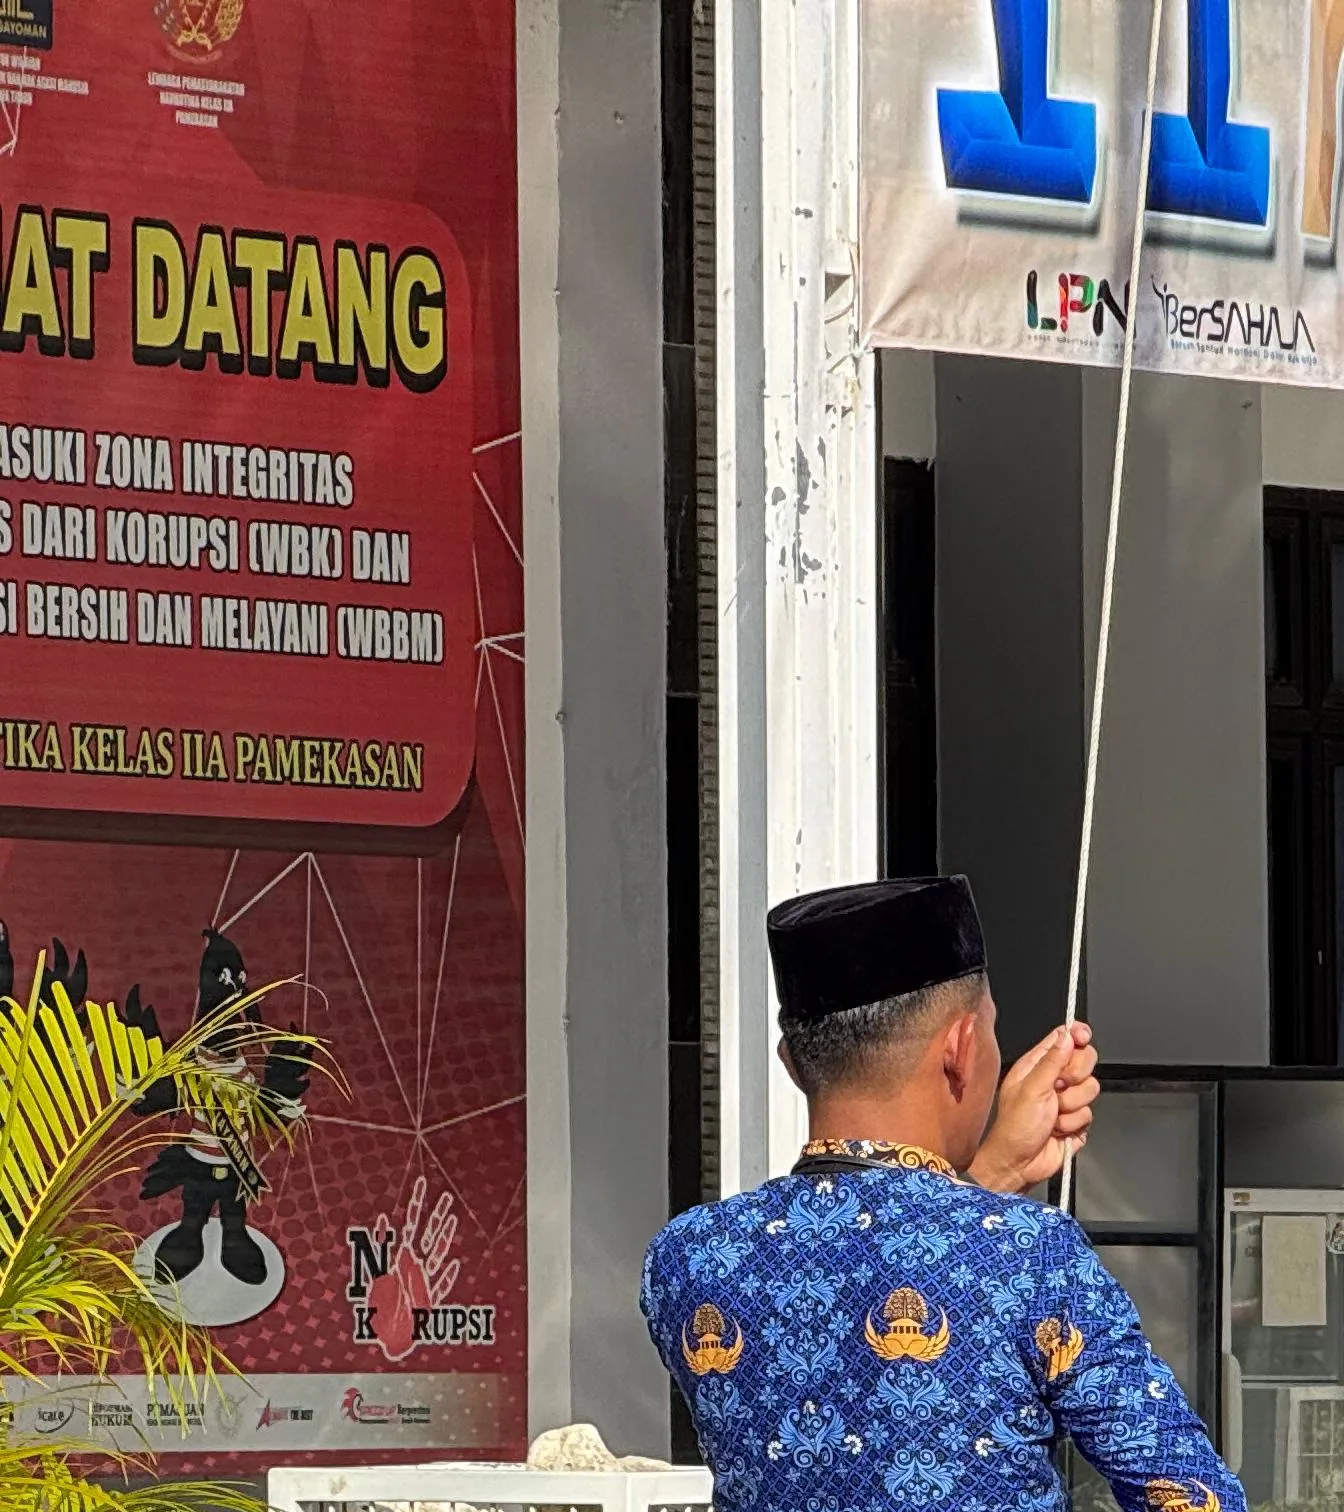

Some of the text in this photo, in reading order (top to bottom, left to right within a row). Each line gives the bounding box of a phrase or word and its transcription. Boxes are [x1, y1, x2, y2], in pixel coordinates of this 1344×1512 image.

[134, 221, 445, 383] DATANG
[1027, 270, 1137, 338] LPN
[95, 434, 174, 491] ZONA
[183, 443, 353, 506] INTEGRITAS
[22, 503, 97, 560] DARI
[107, 510, 239, 571] KORUPSI
[249, 522, 342, 580] (WBK)
[352, 530, 410, 584] DAN
[26, 583, 128, 642] BERSIH
[137, 594, 192, 647] DAN
[201, 598, 328, 655] MELAYANI
[338, 607, 443, 663] (WBBM)
[0, 722, 424, 790] IKA KELAS IIA PAMEKASAN
[356, 1307, 494, 1341] KRUPSI
